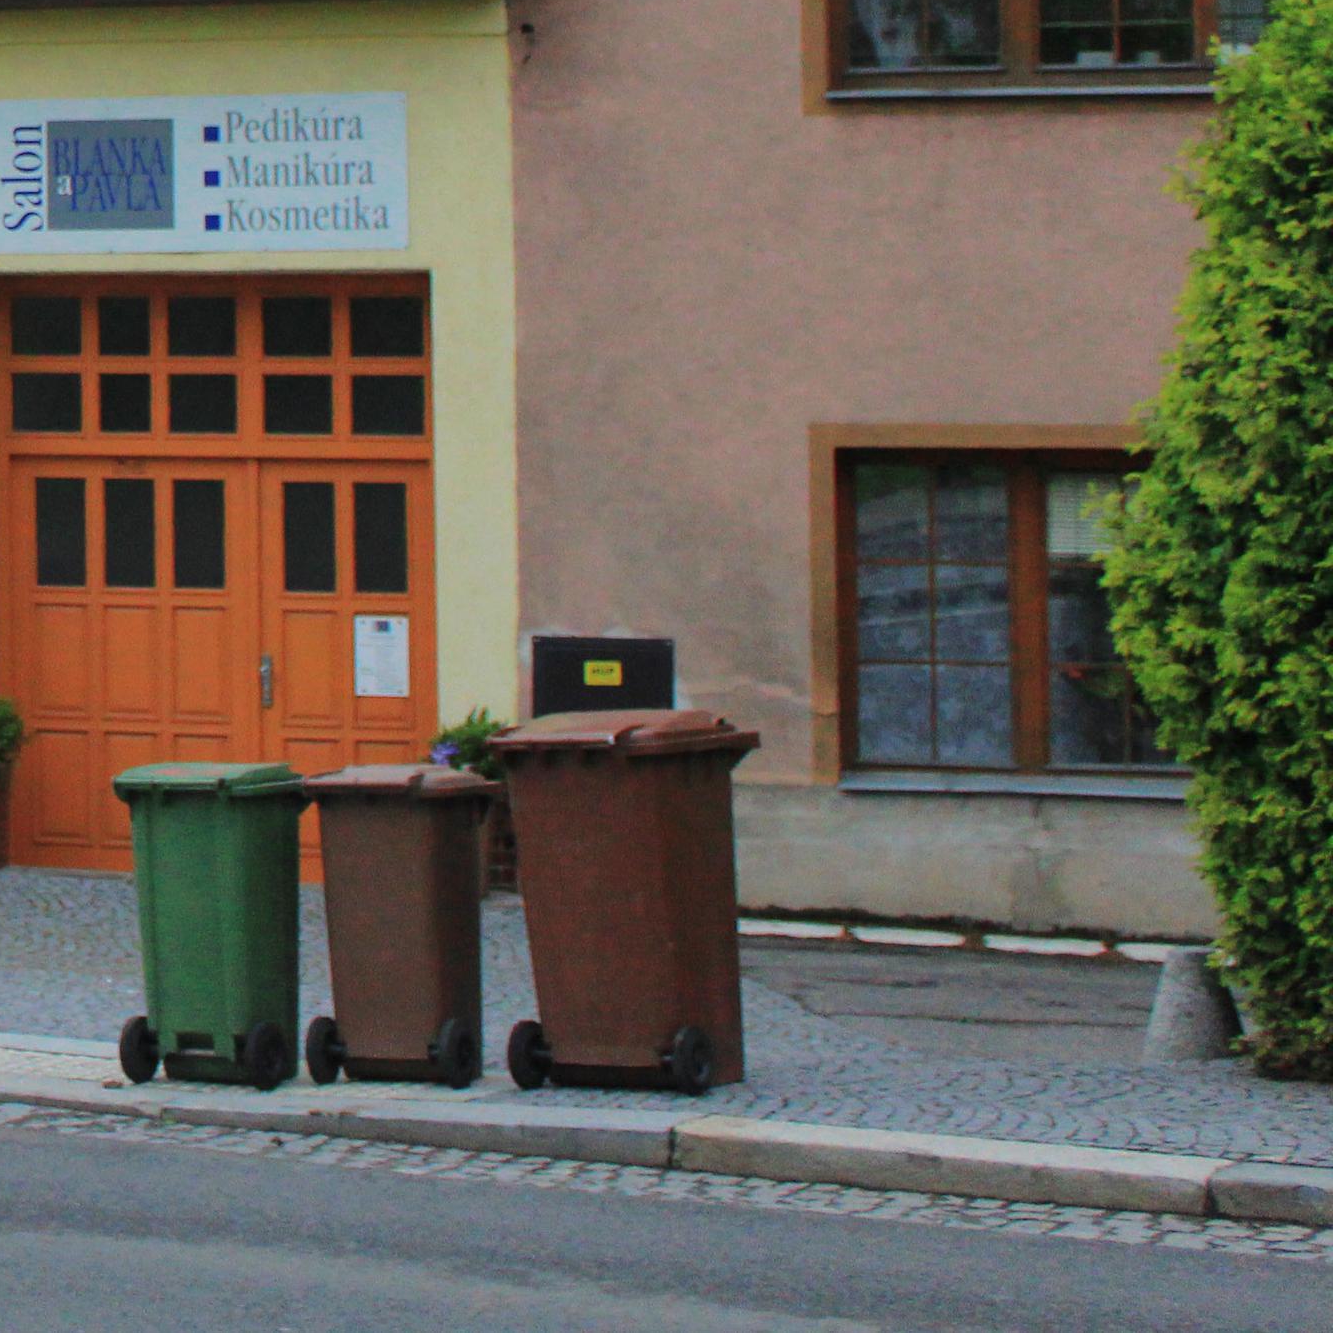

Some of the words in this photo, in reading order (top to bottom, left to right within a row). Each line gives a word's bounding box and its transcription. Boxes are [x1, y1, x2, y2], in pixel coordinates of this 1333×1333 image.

[225, 107, 364, 144] Pedikúra
[53, 137, 166, 176] BLANKA
[226, 152, 375, 188] Manikúra
[0, 125, 44, 232] Salon
[56, 175, 73, 196] a
[70, 170, 163, 212] PAVLA
[226, 195, 390, 233] Kosmetika
